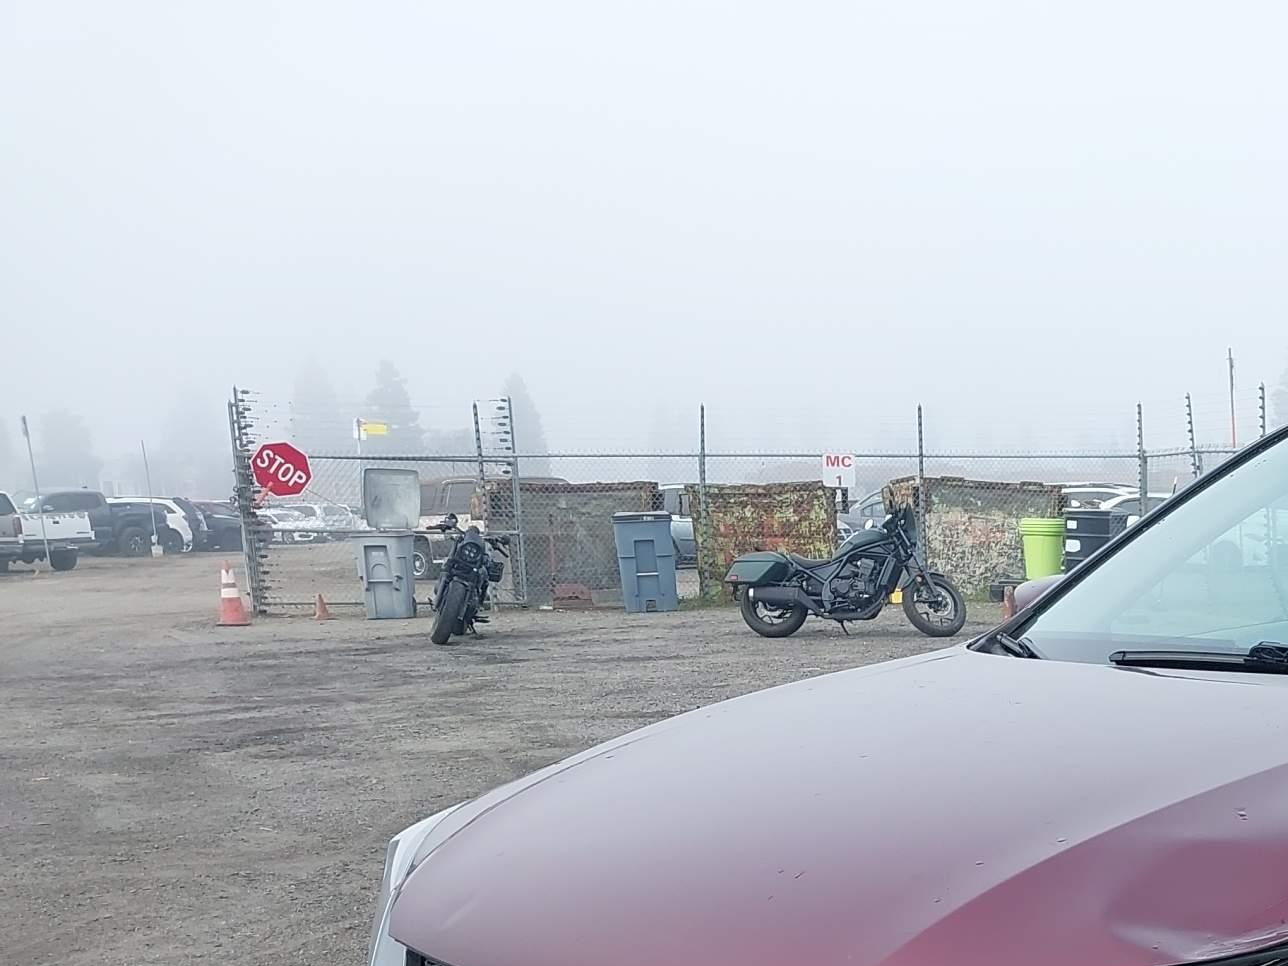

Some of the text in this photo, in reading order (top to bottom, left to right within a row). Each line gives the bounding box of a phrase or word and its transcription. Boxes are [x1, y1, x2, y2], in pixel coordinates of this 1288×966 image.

[256, 449, 307, 487] STOP
[826, 455, 852, 468] MC
[835, 475, 842, 487] 1
